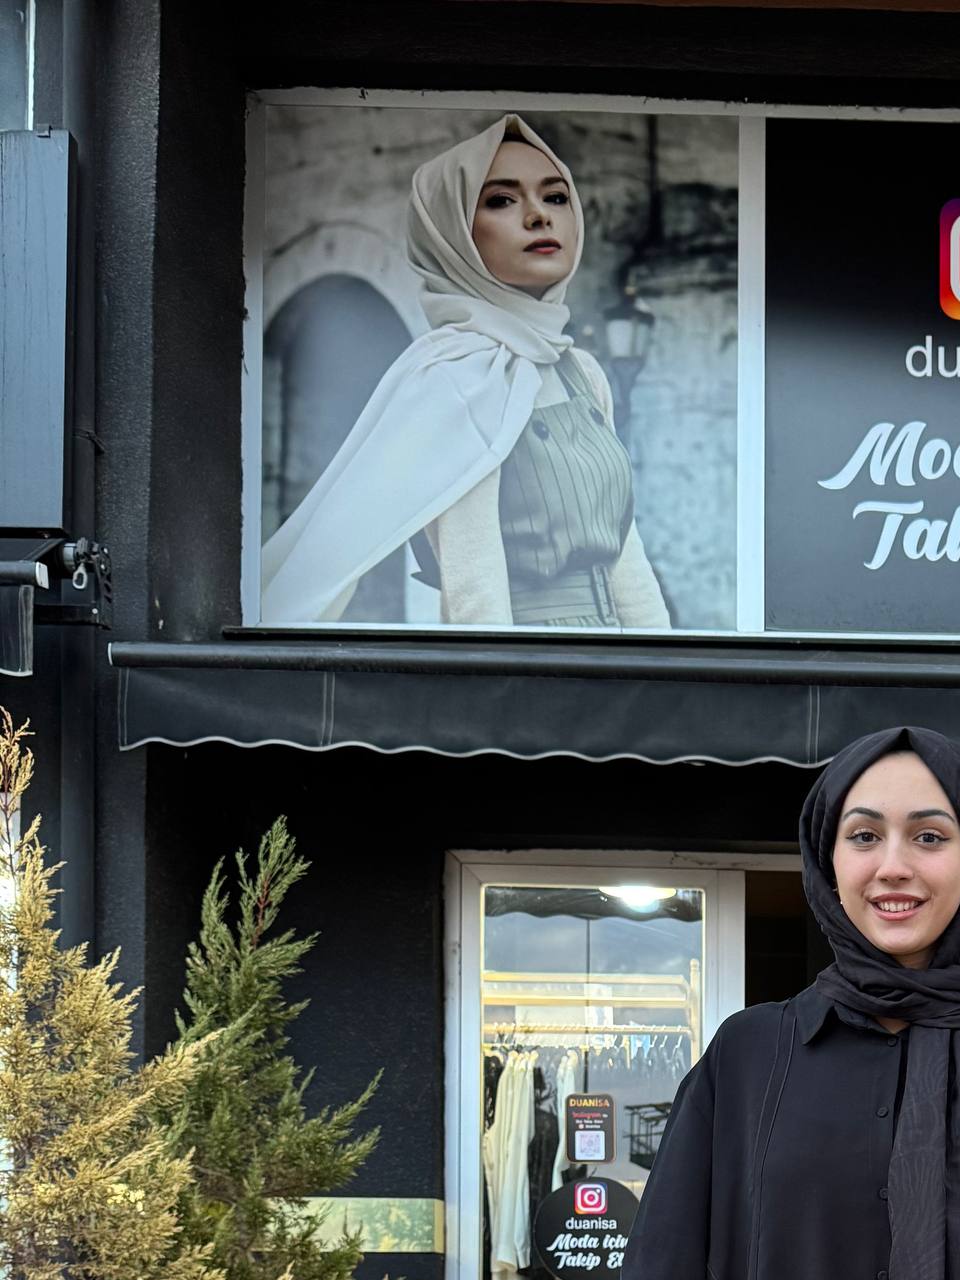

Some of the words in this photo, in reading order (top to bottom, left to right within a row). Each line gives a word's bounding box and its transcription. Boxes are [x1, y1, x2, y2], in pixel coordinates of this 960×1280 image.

[565, 1217, 617, 1229] duanisa
[546, 1233, 599, 1251] Moda
[554, 1251, 601, 1271] Takip
